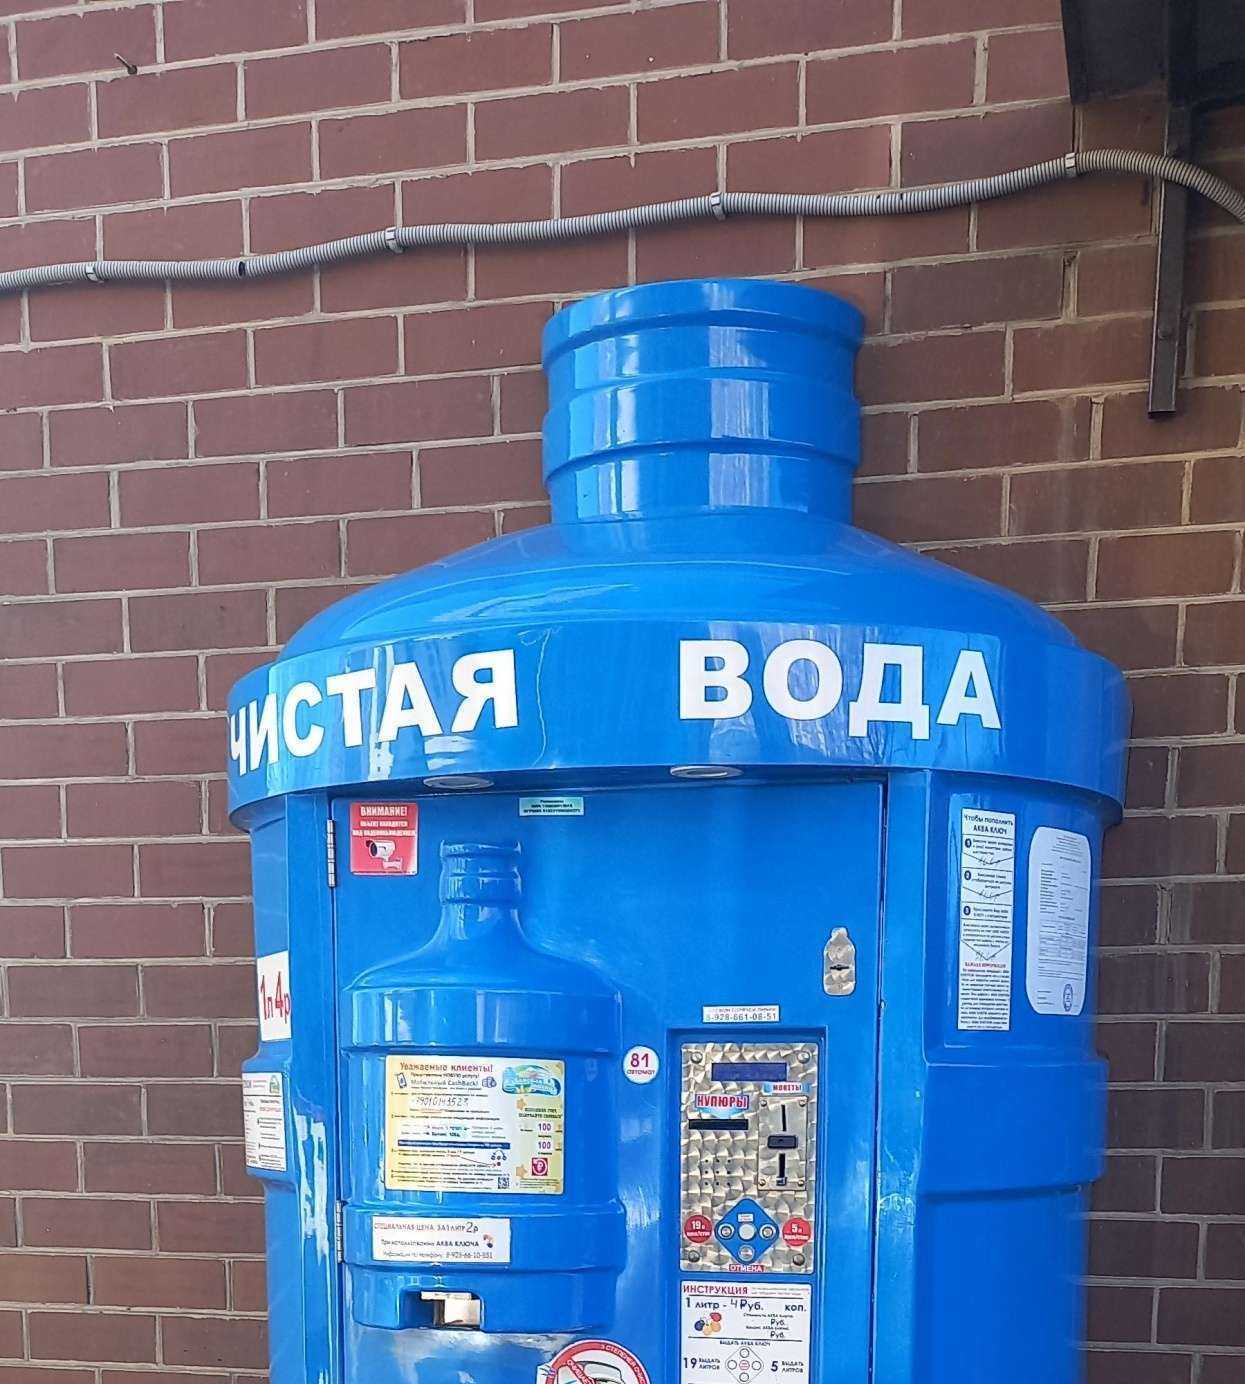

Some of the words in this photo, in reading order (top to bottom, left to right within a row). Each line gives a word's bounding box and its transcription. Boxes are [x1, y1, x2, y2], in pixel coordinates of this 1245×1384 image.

[230, 648, 518, 776] ЧИСТАЯ
[679, 638, 1001, 740] ВОДА
[630, 1053, 649, 1068] 81
[697, 1095, 747, 1108] КУПЮРЫ
[538, 1123, 552, 1132] 100
[538, 1141, 552, 1150] 100
[691, 1220, 702, 1230] 19
[791, 1222, 799, 1233] 5
[730, 1264, 763, 1273] ОТМЕНА
[683, 1285, 748, 1295] ИНСТРУКЦИЯ
[685, 1297, 691, 1308] 1
[695, 1301, 720, 1311] литр
[784, 1304, 807, 1312] коп.
[683, 1357, 698, 1369] 19
[770, 1360, 779, 1372] 5
